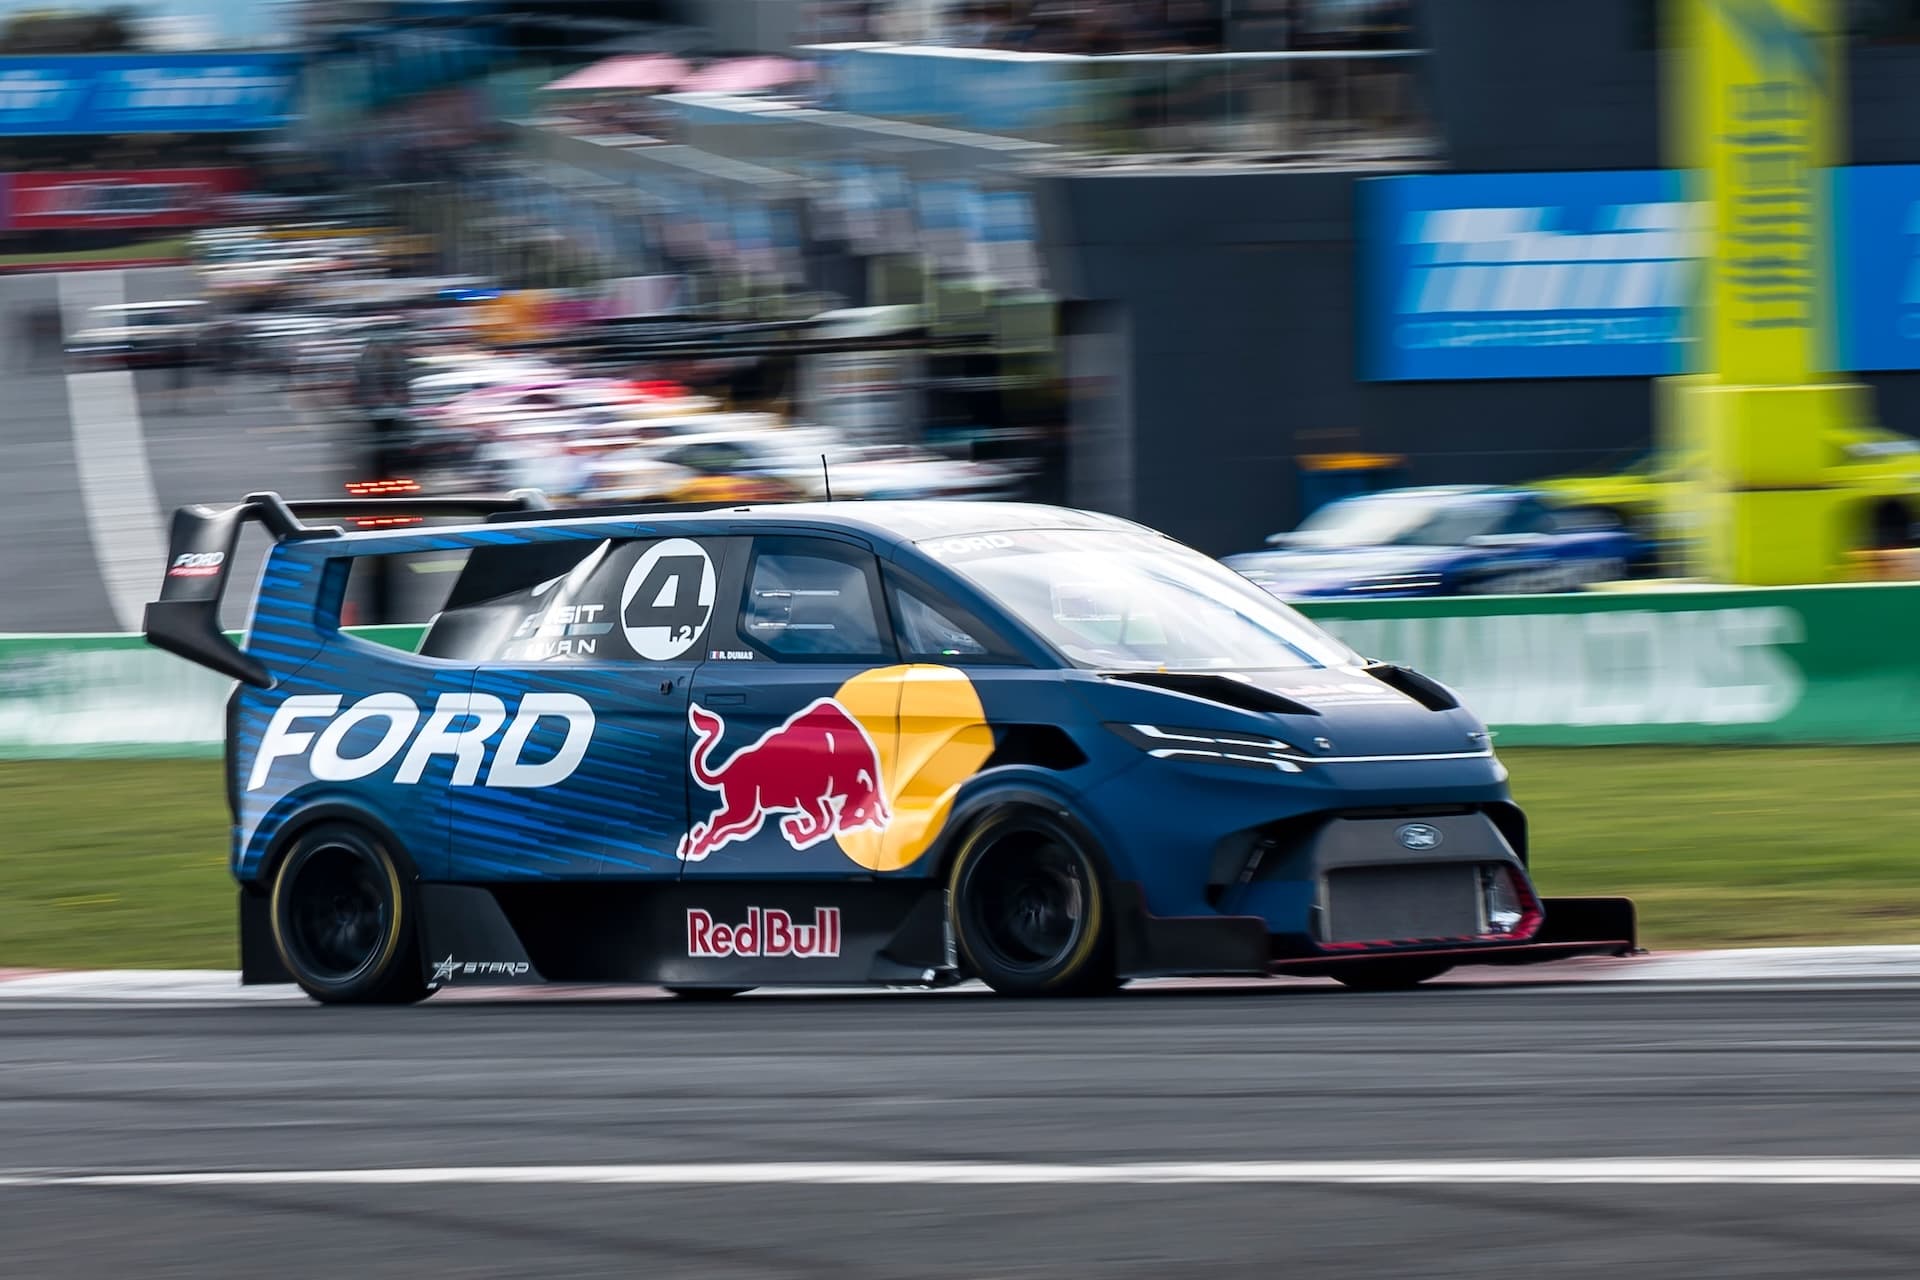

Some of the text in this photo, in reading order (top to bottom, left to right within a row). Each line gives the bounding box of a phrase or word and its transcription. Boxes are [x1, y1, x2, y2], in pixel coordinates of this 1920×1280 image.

[172, 551, 225, 568] FORD
[727, 650, 754, 660] DUMAS
[246, 692, 596, 792] FORD
[687, 906, 840, 958] Red Bull
[463, 962, 529, 977] STARD
